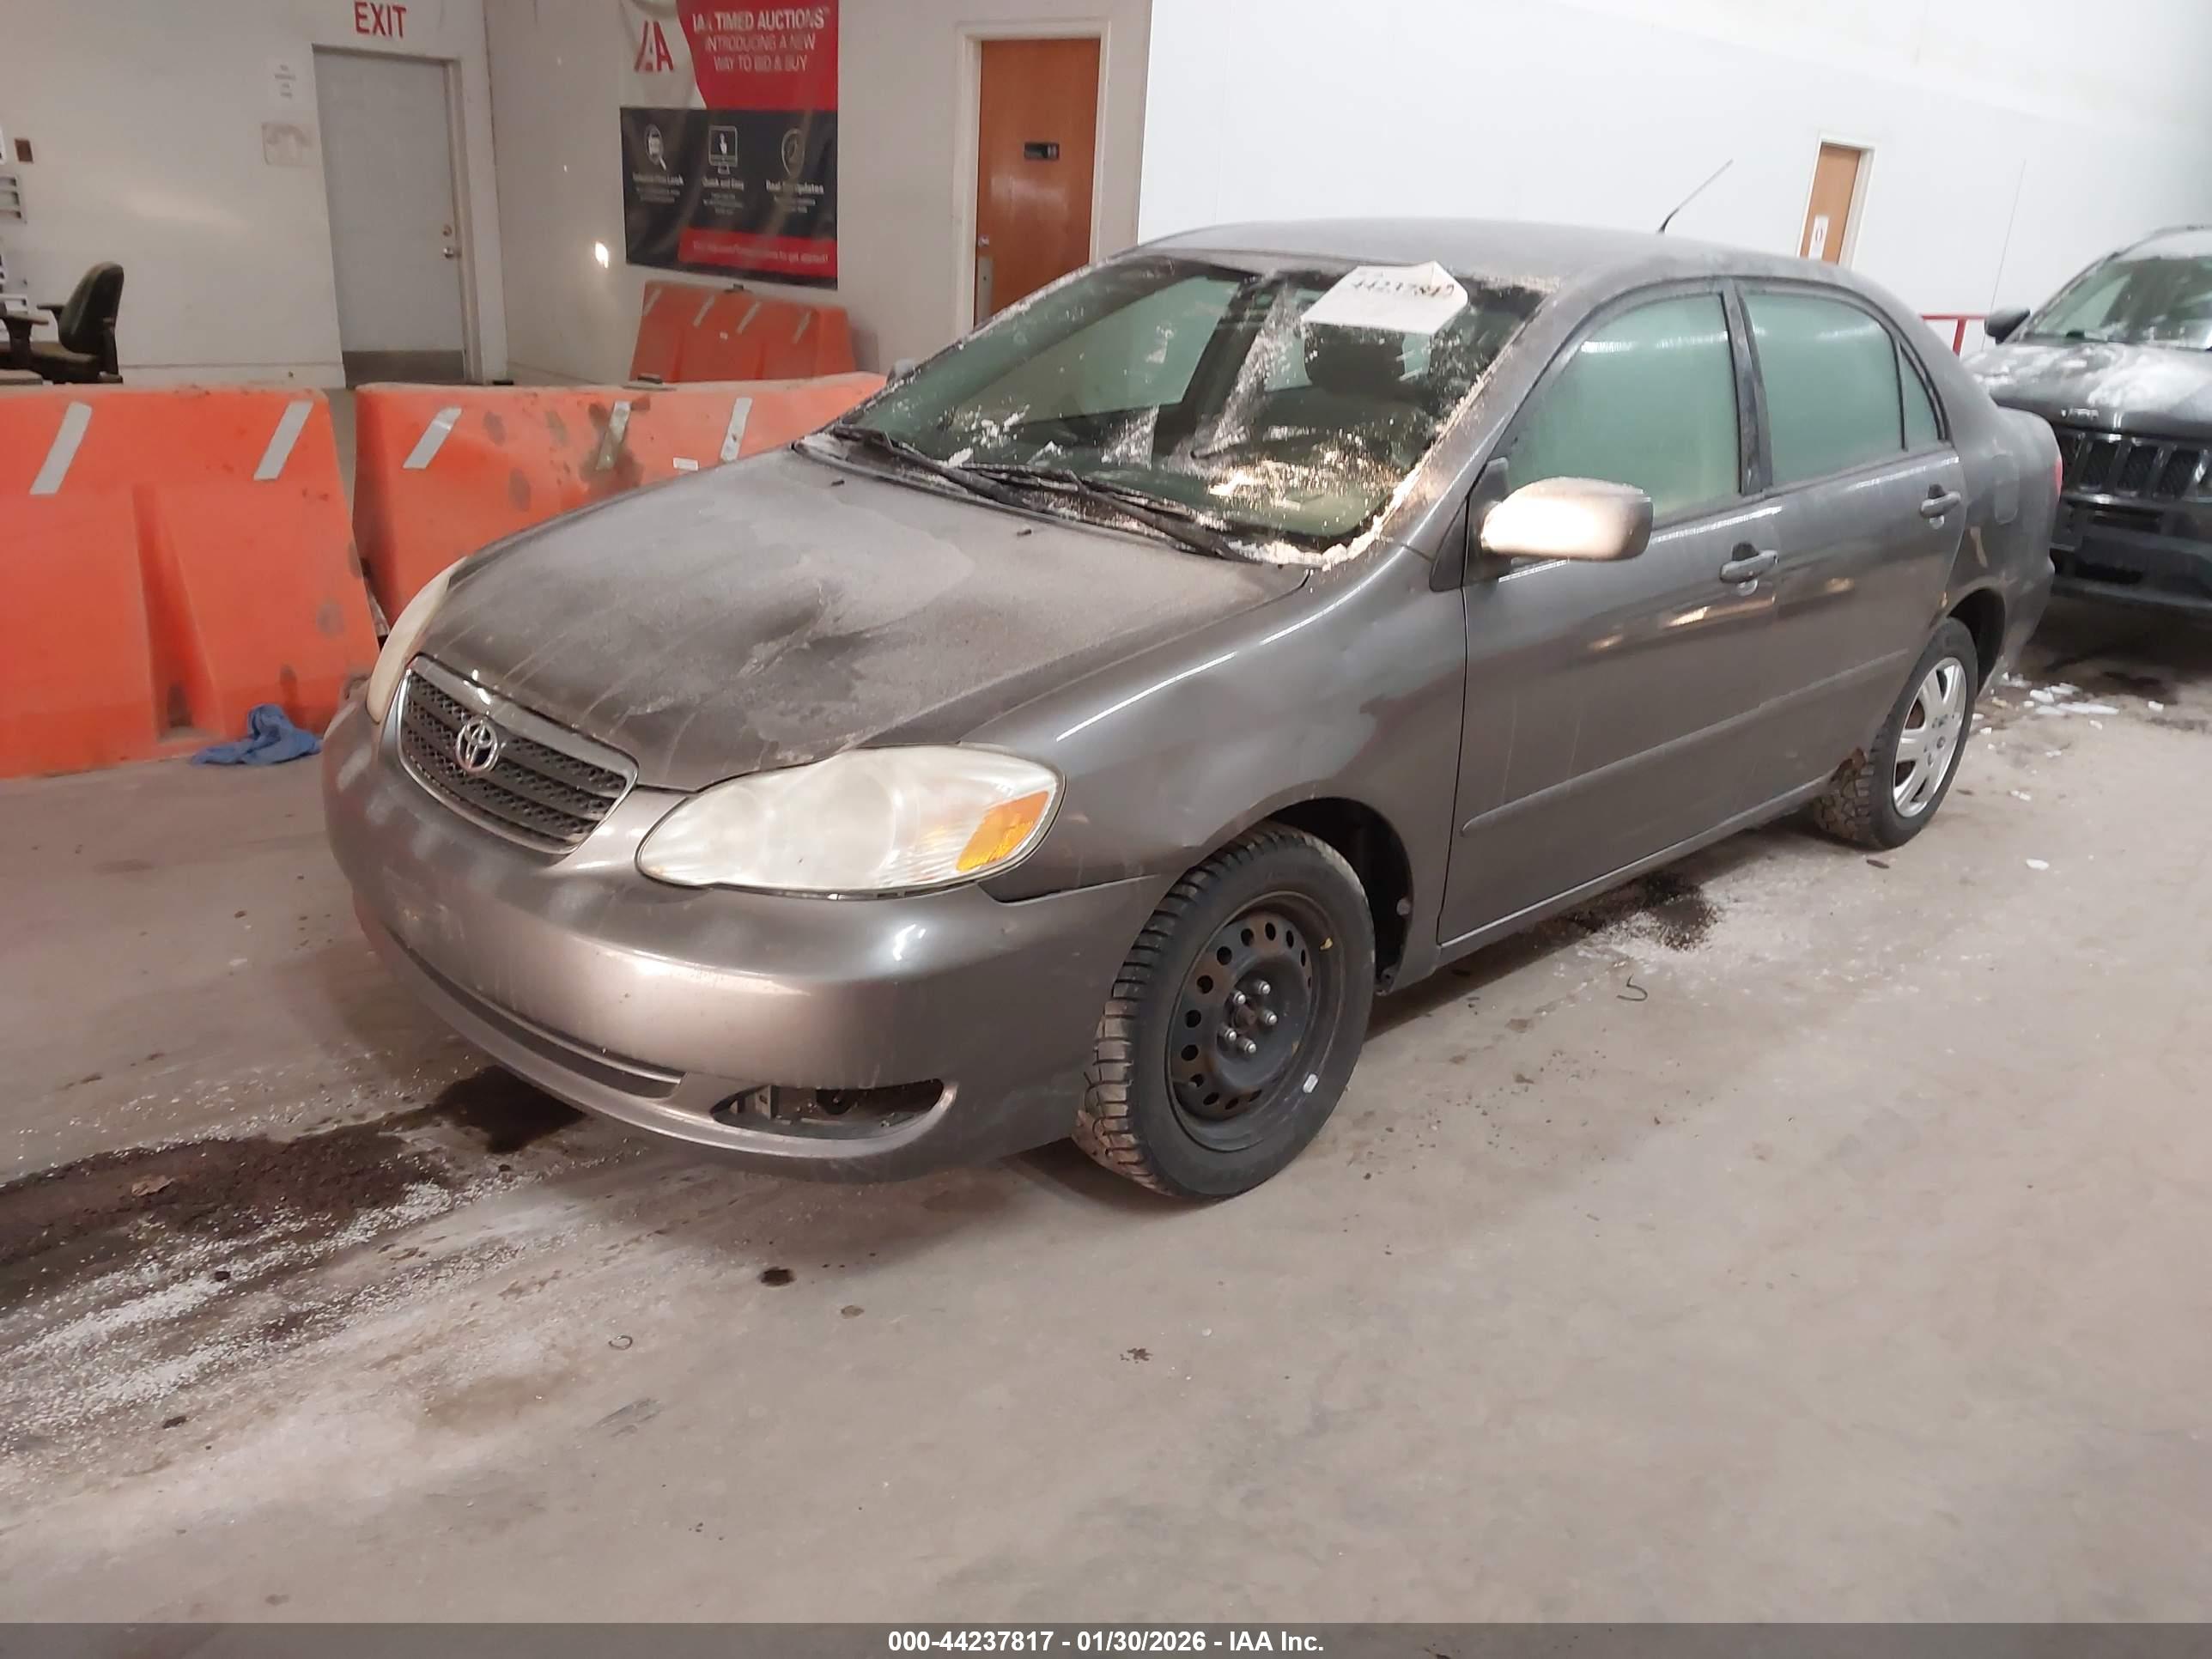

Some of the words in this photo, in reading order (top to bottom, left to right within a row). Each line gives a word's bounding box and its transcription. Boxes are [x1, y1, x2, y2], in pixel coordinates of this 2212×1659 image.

[355, 2, 407, 39] EXIT
[692, 12, 713, 33] IA
[714, 10, 755, 31] TIMED
[738, 54, 752, 72] TO
